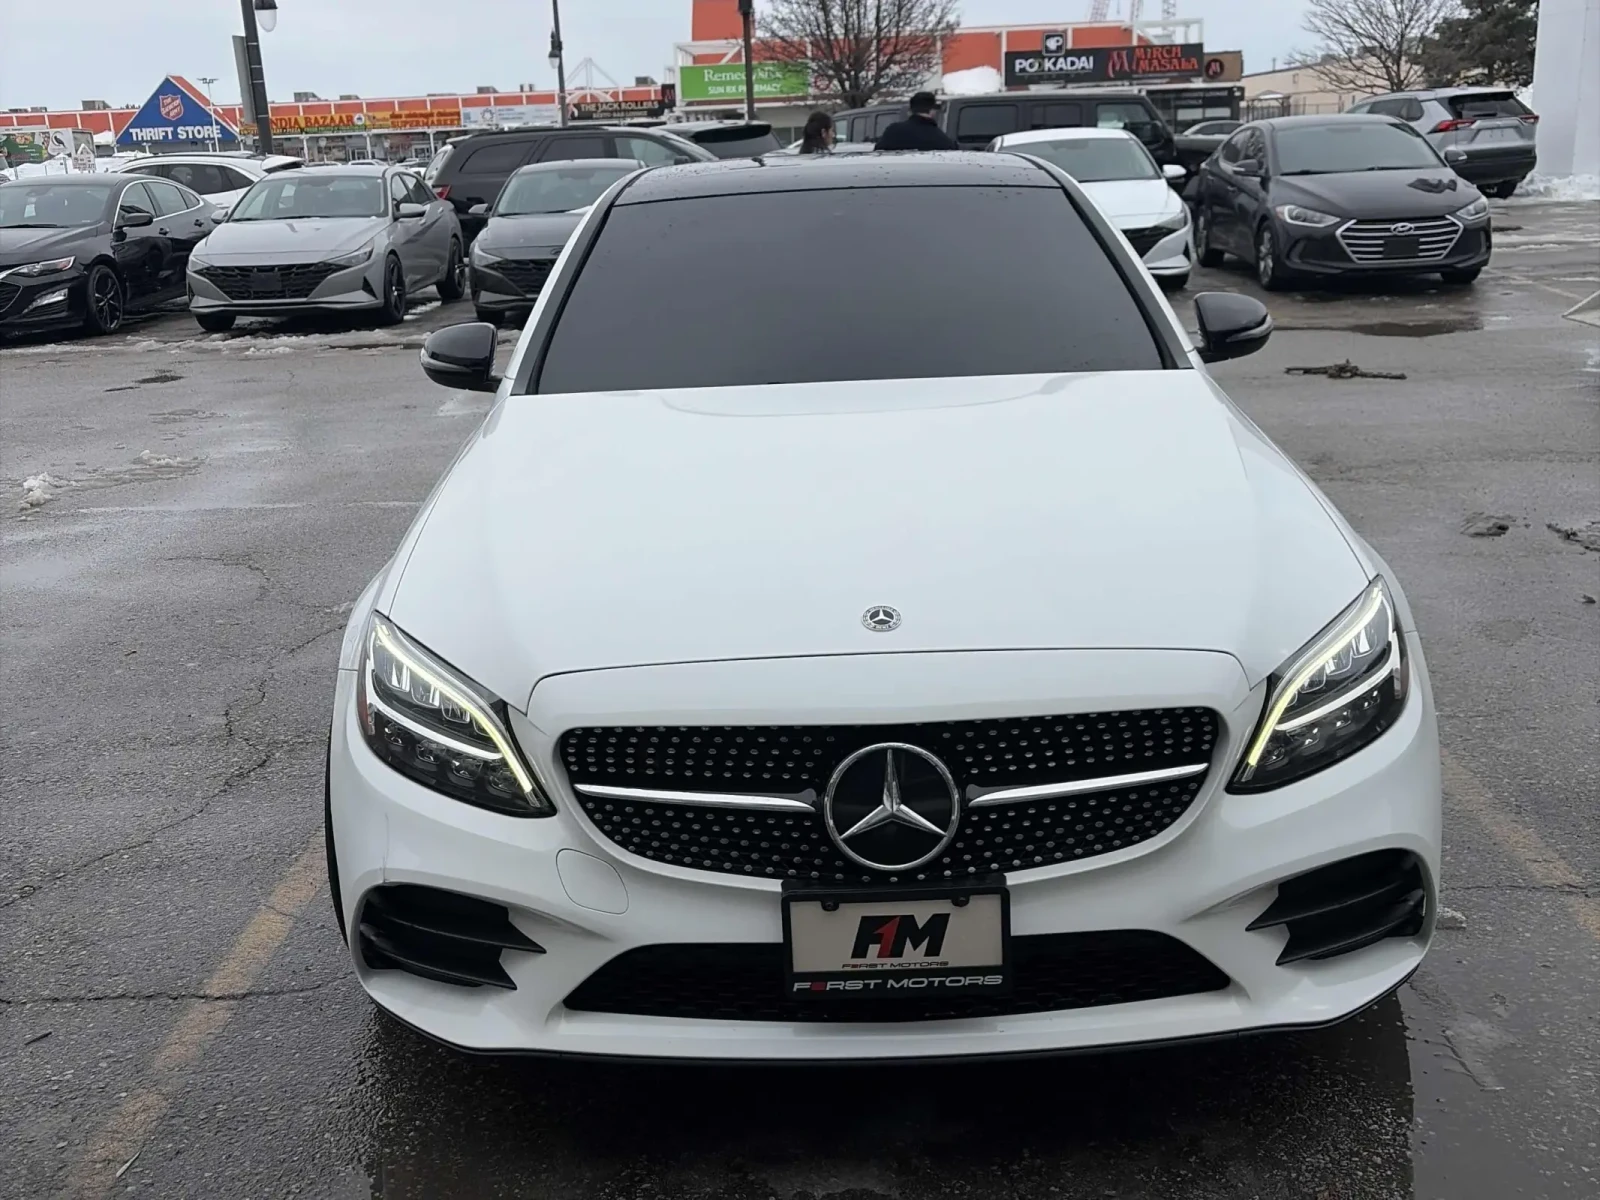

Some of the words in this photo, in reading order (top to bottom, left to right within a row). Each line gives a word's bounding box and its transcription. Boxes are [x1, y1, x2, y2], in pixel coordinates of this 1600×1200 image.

[1134, 45, 1182, 59] MIRCH
[1138, 57, 1198, 74] MASALA
[708, 86, 725, 95] SUN
[580, 103, 597, 112] THE
[597, 102, 620, 113] JACK
[620, 100, 660, 110] ROLLERS
[304, 114, 355, 129] BAZAAR
[129, 126, 174, 141] THRIFT
[177, 125, 222, 139] STORE
[889, 960, 949, 968] MOTORS
[886, 974, 1004, 989] MOTORS
